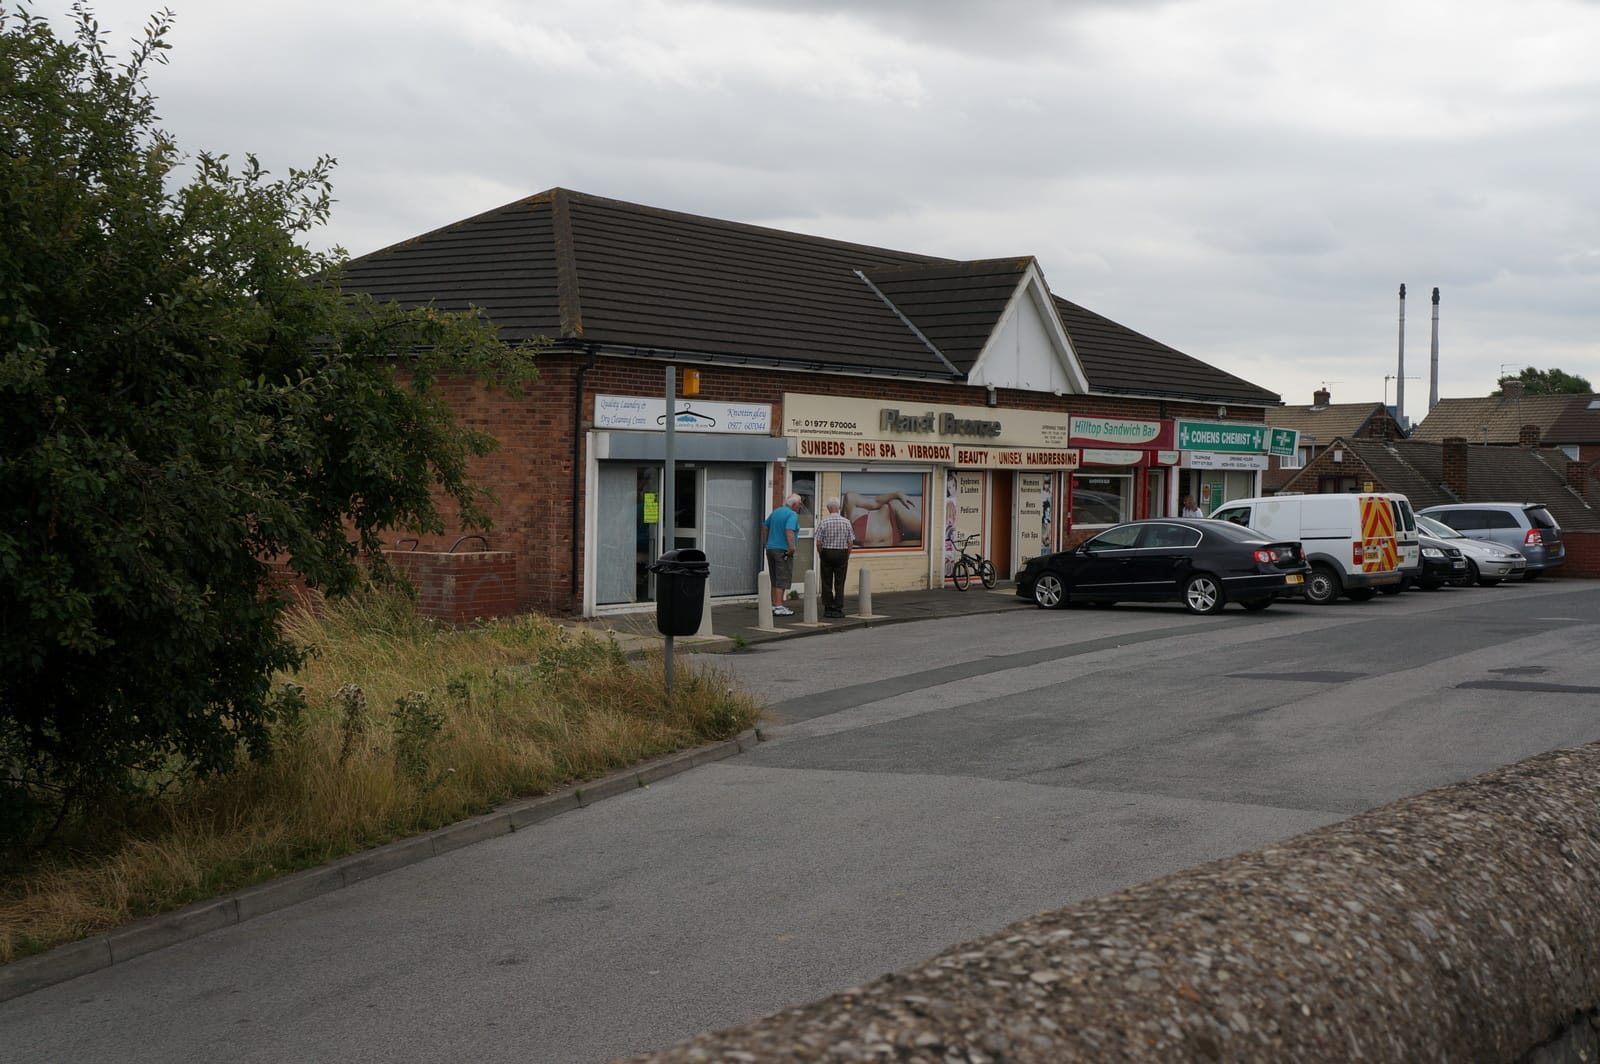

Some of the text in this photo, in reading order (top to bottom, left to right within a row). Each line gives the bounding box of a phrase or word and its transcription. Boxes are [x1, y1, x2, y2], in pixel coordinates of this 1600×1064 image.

[727, 408, 766, 420] Knottingley
[880, 408, 1002, 438] Planet Bronze
[1074, 420, 1156, 437] Hilltop Sandwich Bar
[1191, 430, 1251, 445] COHENS CHEMIST
[801, 440, 950, 460] SUNBEDS FISH SPA VIBROBOX
[958, 450, 988, 464] BEAUTY
[998, 452, 1022, 465] UNISEX
[1026, 452, 1077, 465] HAIRDRESSING
